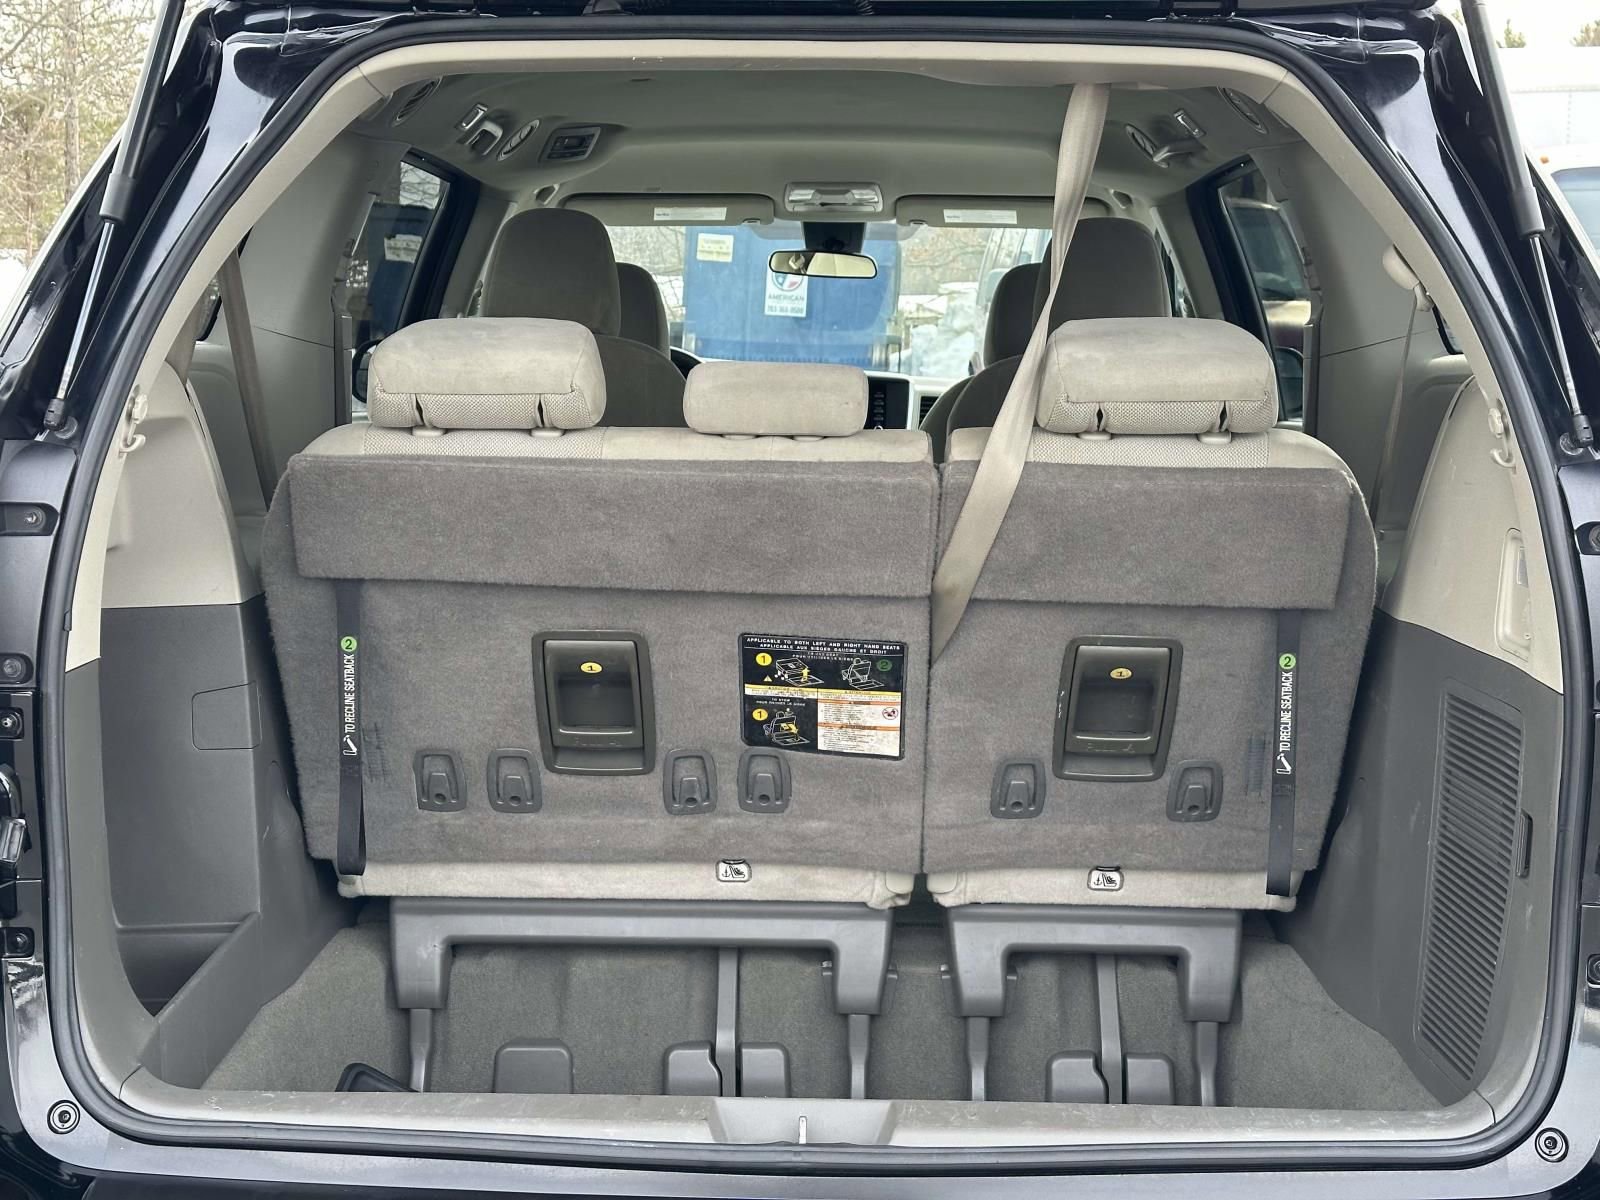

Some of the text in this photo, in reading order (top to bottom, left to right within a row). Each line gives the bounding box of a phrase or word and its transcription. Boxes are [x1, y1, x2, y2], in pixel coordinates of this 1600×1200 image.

[768, 293, 804, 301] AMERICAN
[343, 654, 356, 733] TO RECLINE SEATBACK
[1279, 671, 1293, 752] TO RECLINE SEATBACK
